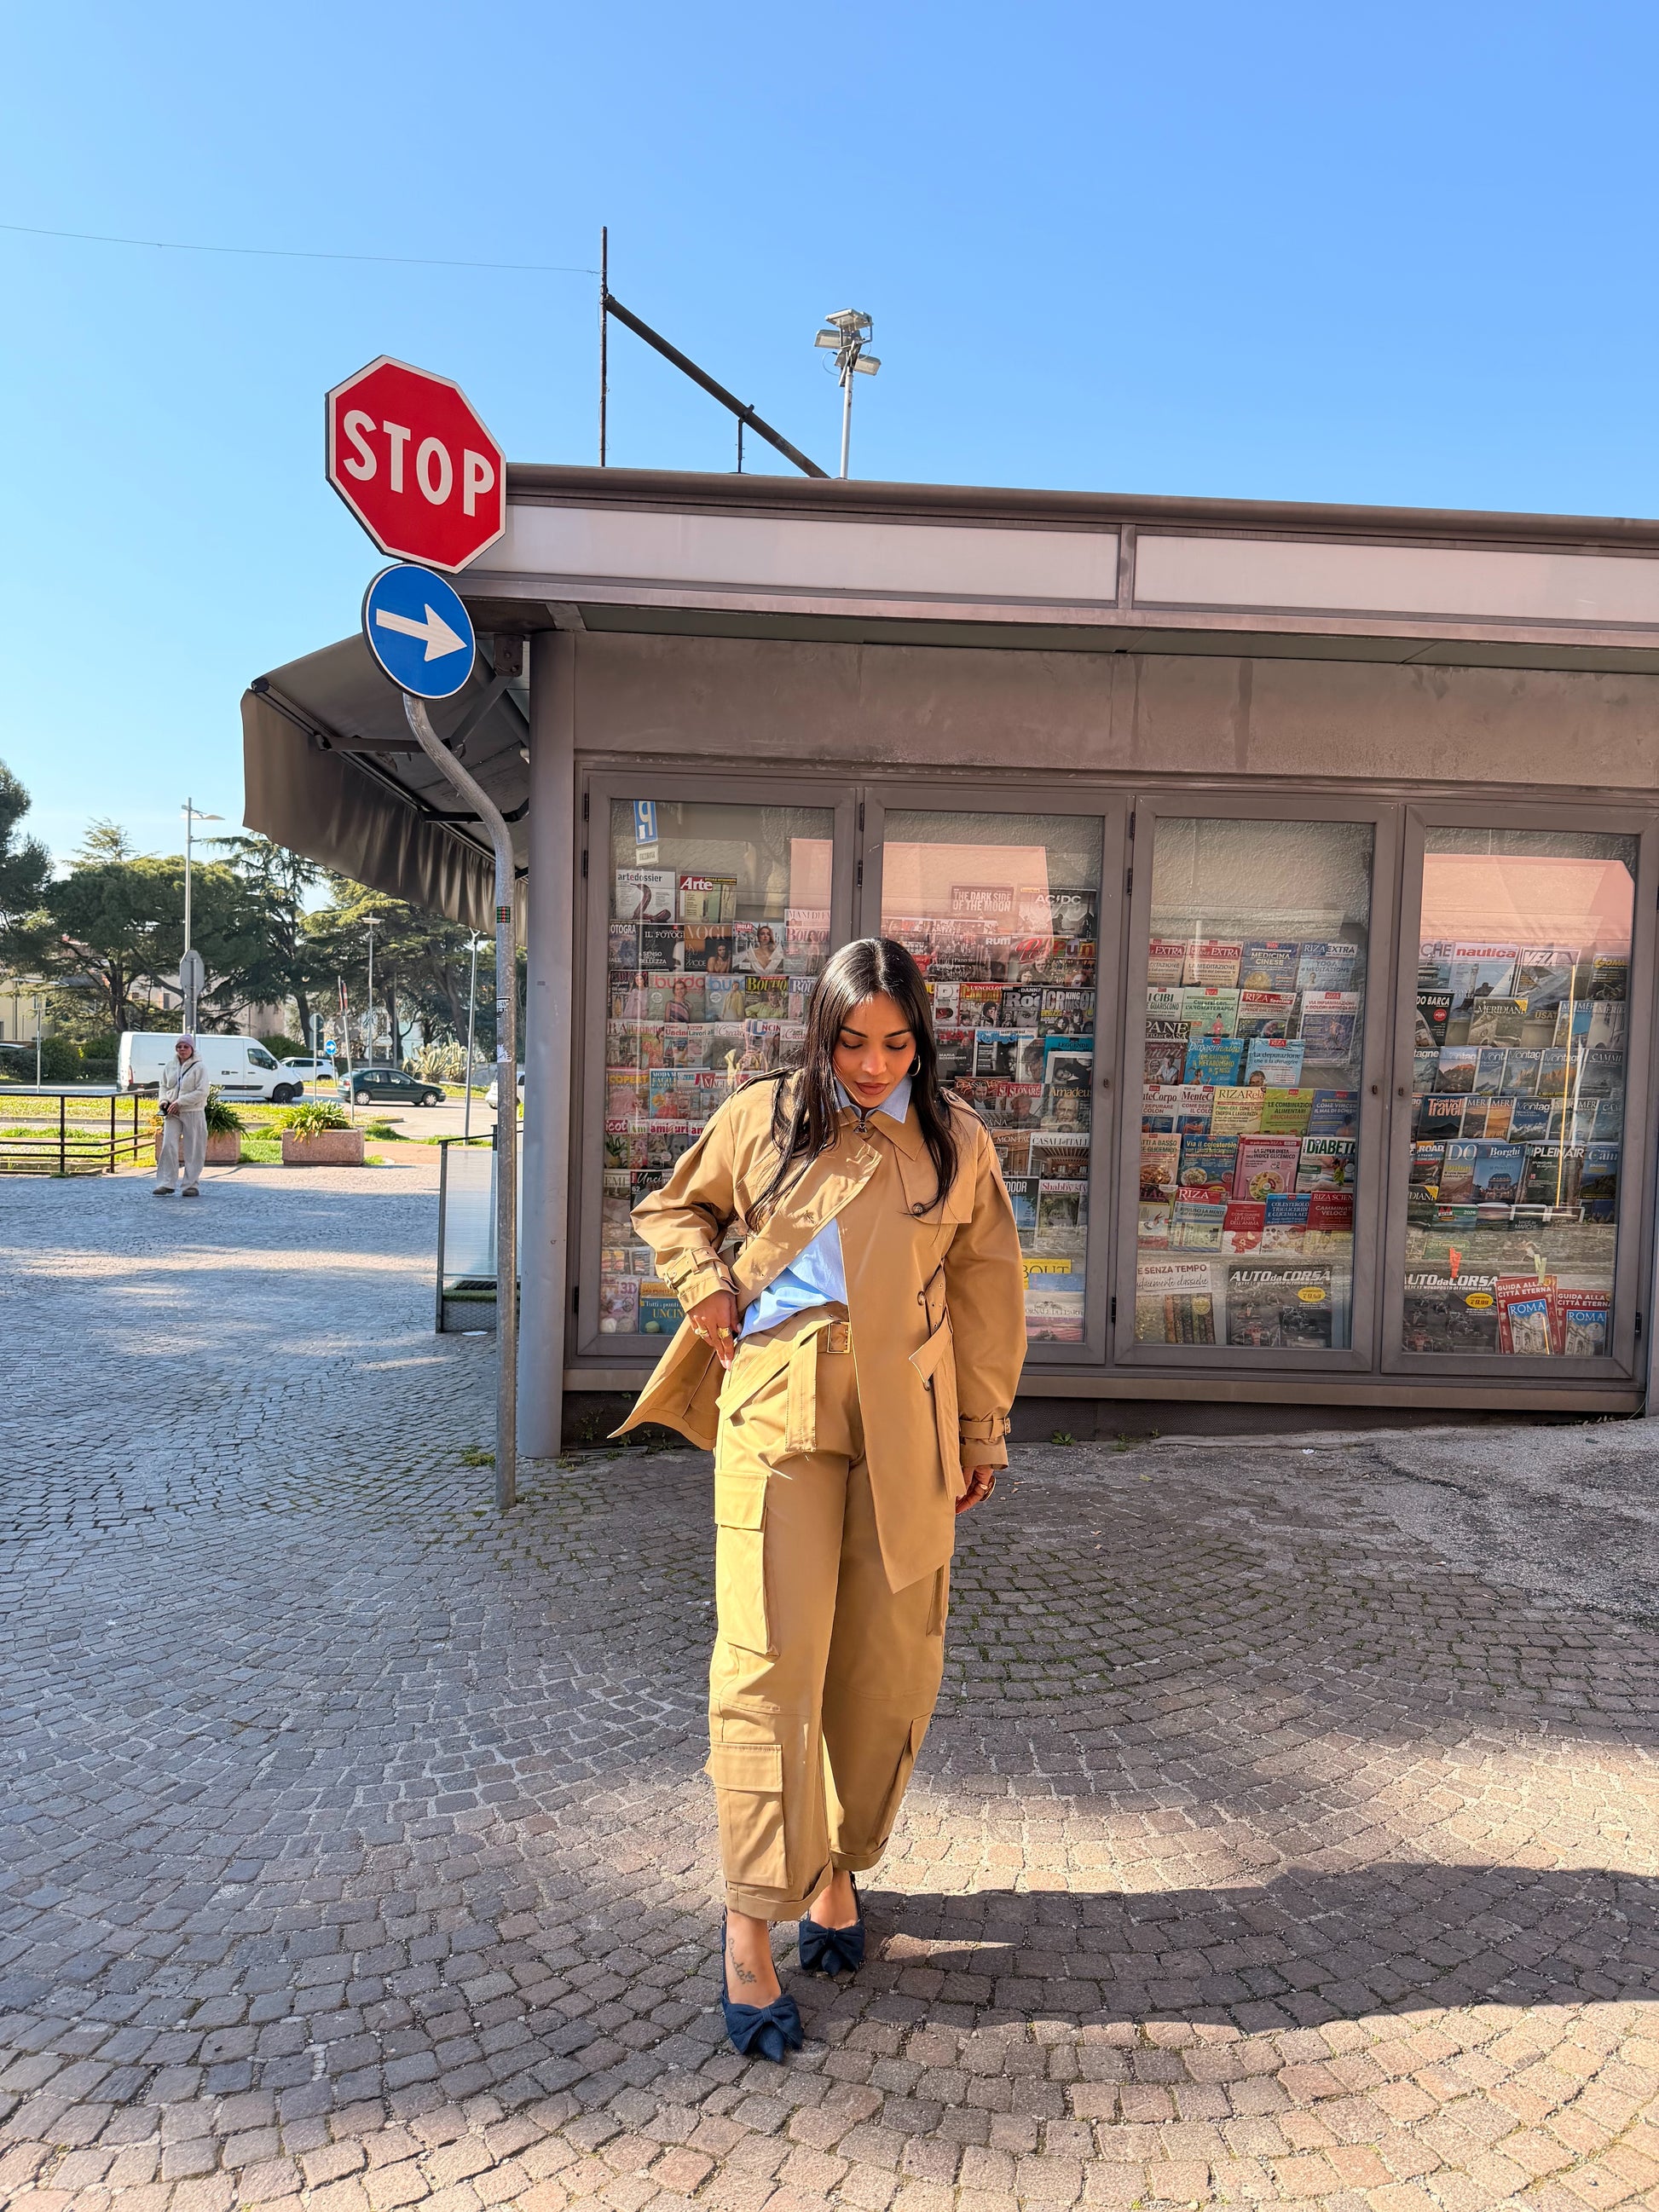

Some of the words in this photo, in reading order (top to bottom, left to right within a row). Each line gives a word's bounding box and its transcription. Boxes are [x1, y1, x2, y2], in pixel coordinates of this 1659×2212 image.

[343, 409, 494, 517] STOP
[618, 873, 662, 882] artedossier
[680, 877, 713, 891] Arte
[954, 892, 968, 901] THE
[971, 892, 991, 902] DARK
[953, 900, 963, 910] OF
[966, 901, 982, 910] THE
[985, 902, 1009, 911] MOON
[1155, 946, 1182, 955] EXTRA
[1211, 948, 1239, 956] EXTRA
[1421, 944, 1452, 957] CHE
[1456, 948, 1517, 958] nautica
[1155, 993, 1174, 1002] CIBI
[1246, 993, 1269, 1002] RIZA
[1427, 996, 1449, 1005] BARCA
[1009, 1086, 1041, 1096] SUONARE
[1490, 1146, 1521, 1158] Borghi
[1042, 1183, 1072, 1192] Shabby
[1179, 1189, 1209, 1200] RIZA
[1145, 1266, 1173, 1274] SENZA
[1175, 1264, 1207, 1273] TEMPO
[621, 1282, 637, 1294] 3D
[1522, 1286, 1552, 1295] ETERNA
[1510, 1302, 1546, 1314] ROMA
[1569, 1312, 1604, 1321] ROMA
